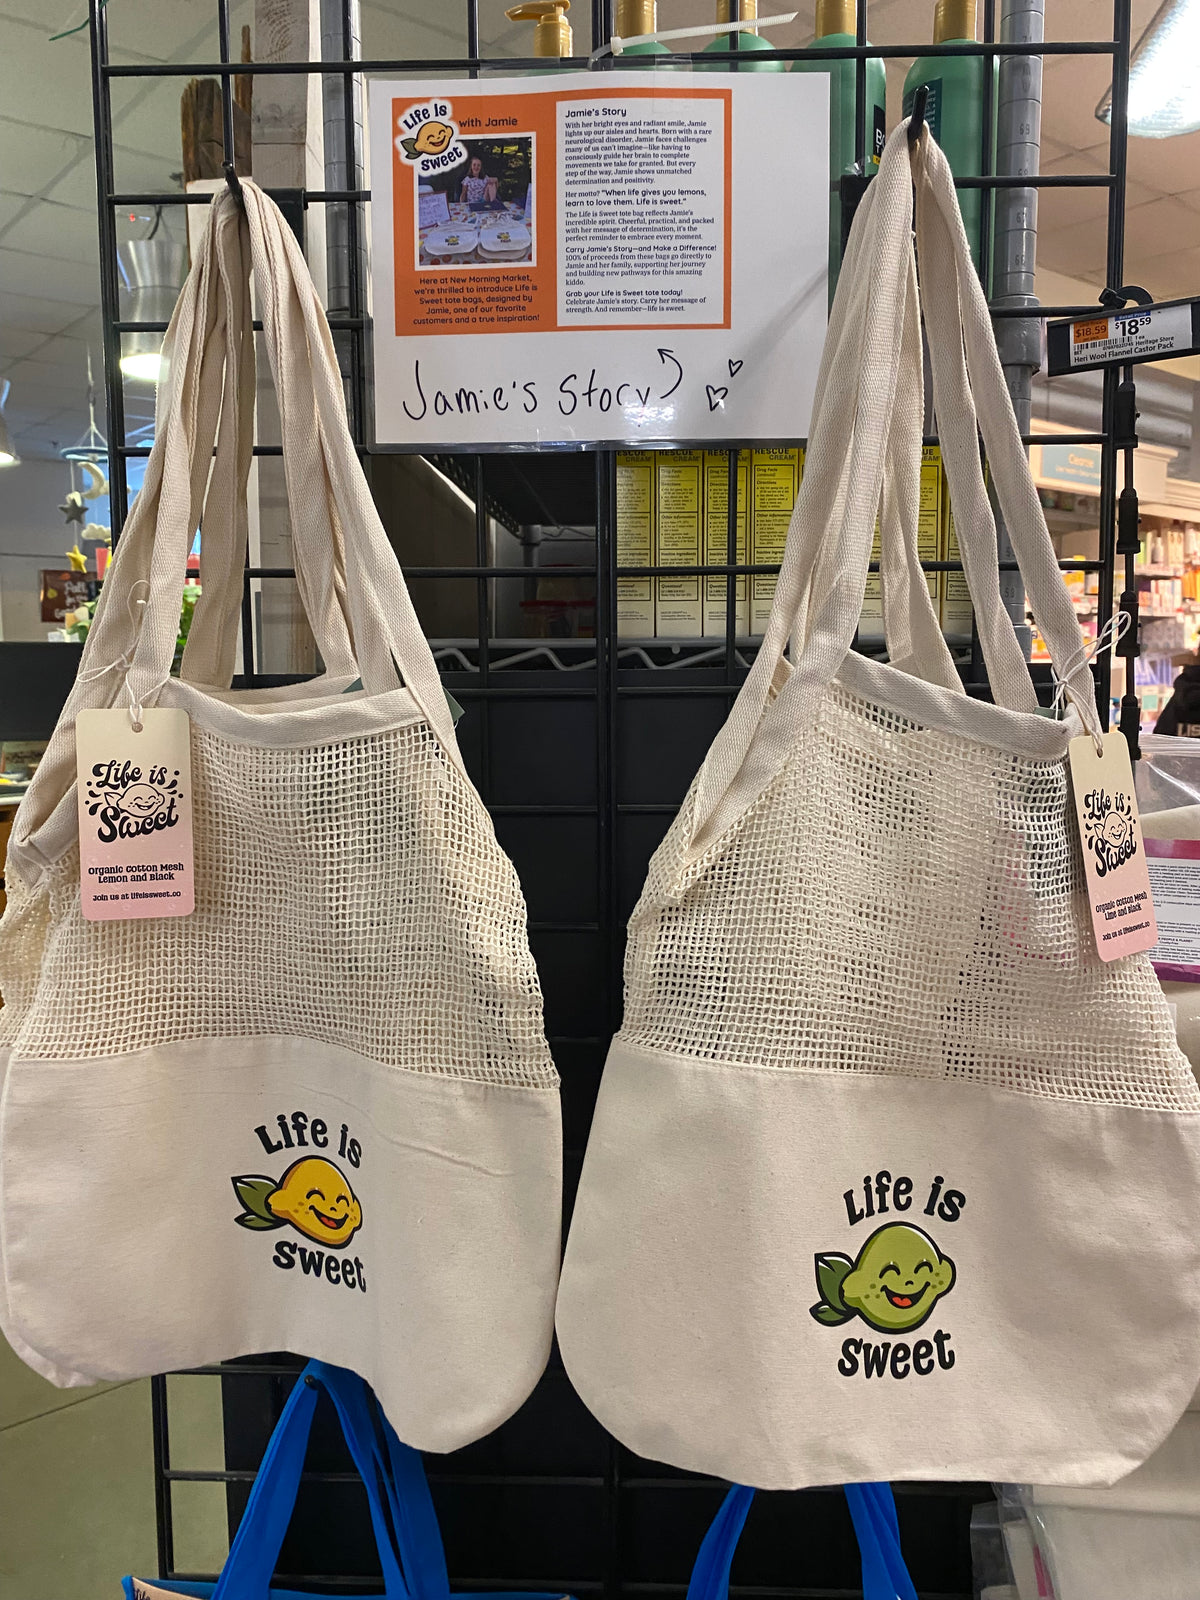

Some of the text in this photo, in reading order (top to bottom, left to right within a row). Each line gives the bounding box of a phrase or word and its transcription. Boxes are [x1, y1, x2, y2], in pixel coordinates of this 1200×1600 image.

[403, 108, 430, 130] Life
[459, 117, 518, 127] with Jamie
[566, 108, 626, 118] Jamie's Story
[469, 276, 500, 284] Morning
[502, 274, 532, 282] Market,
[463, 296, 484, 304] bags,
[486, 295, 520, 303] designed
[523, 294, 532, 302] by
[1075, 325, 1106, 337] $18.59
[1074, 355, 1088, 363] Heri
[1090, 352, 1106, 361] Wool
[1108, 348, 1132, 358] Flannel
[1134, 345, 1156, 353] Castor
[1158, 342, 1173, 350] Pack
[403, 360, 652, 427] Jamie's Story
[92, 759, 168, 791] Life is
[1084, 788, 1124, 821] Life is
[98, 797, 179, 843] Sweet
[1095, 824, 1136, 877] Sweet
[88, 862, 184, 875] Organic Cotton Mesh
[98, 872, 174, 883] Lemon and Black
[1096, 891, 1147, 913] Organic Cotton Mesh
[1105, 902, 1142, 920] Lime and Black
[254, 1111, 362, 1168] Life is
[843, 1170, 966, 1226] Life is
